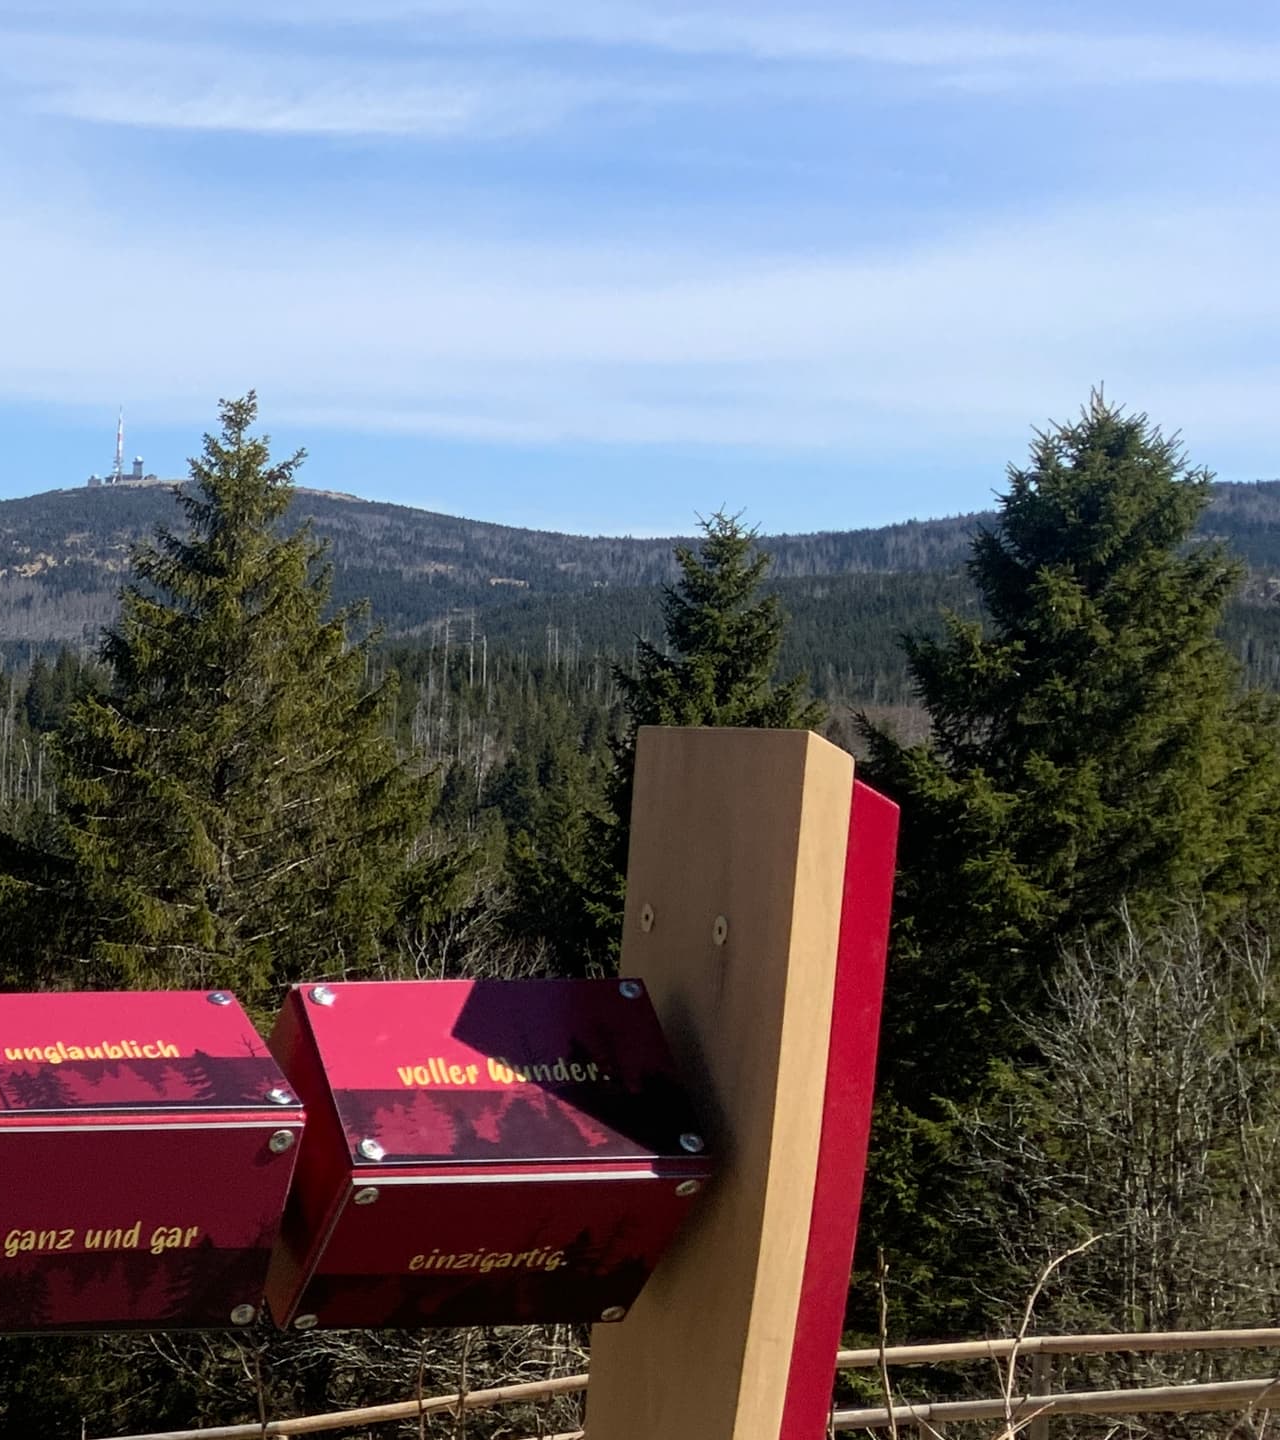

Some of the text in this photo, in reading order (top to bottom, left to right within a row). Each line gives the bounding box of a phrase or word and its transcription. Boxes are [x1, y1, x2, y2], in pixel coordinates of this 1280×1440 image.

[4, 1040, 181, 1064] unglaublich
[397, 1056, 610, 1087] voller Wunder.
[4, 1223, 199, 1257] ganz und gar
[408, 1247, 568, 1273] einzigartig.
